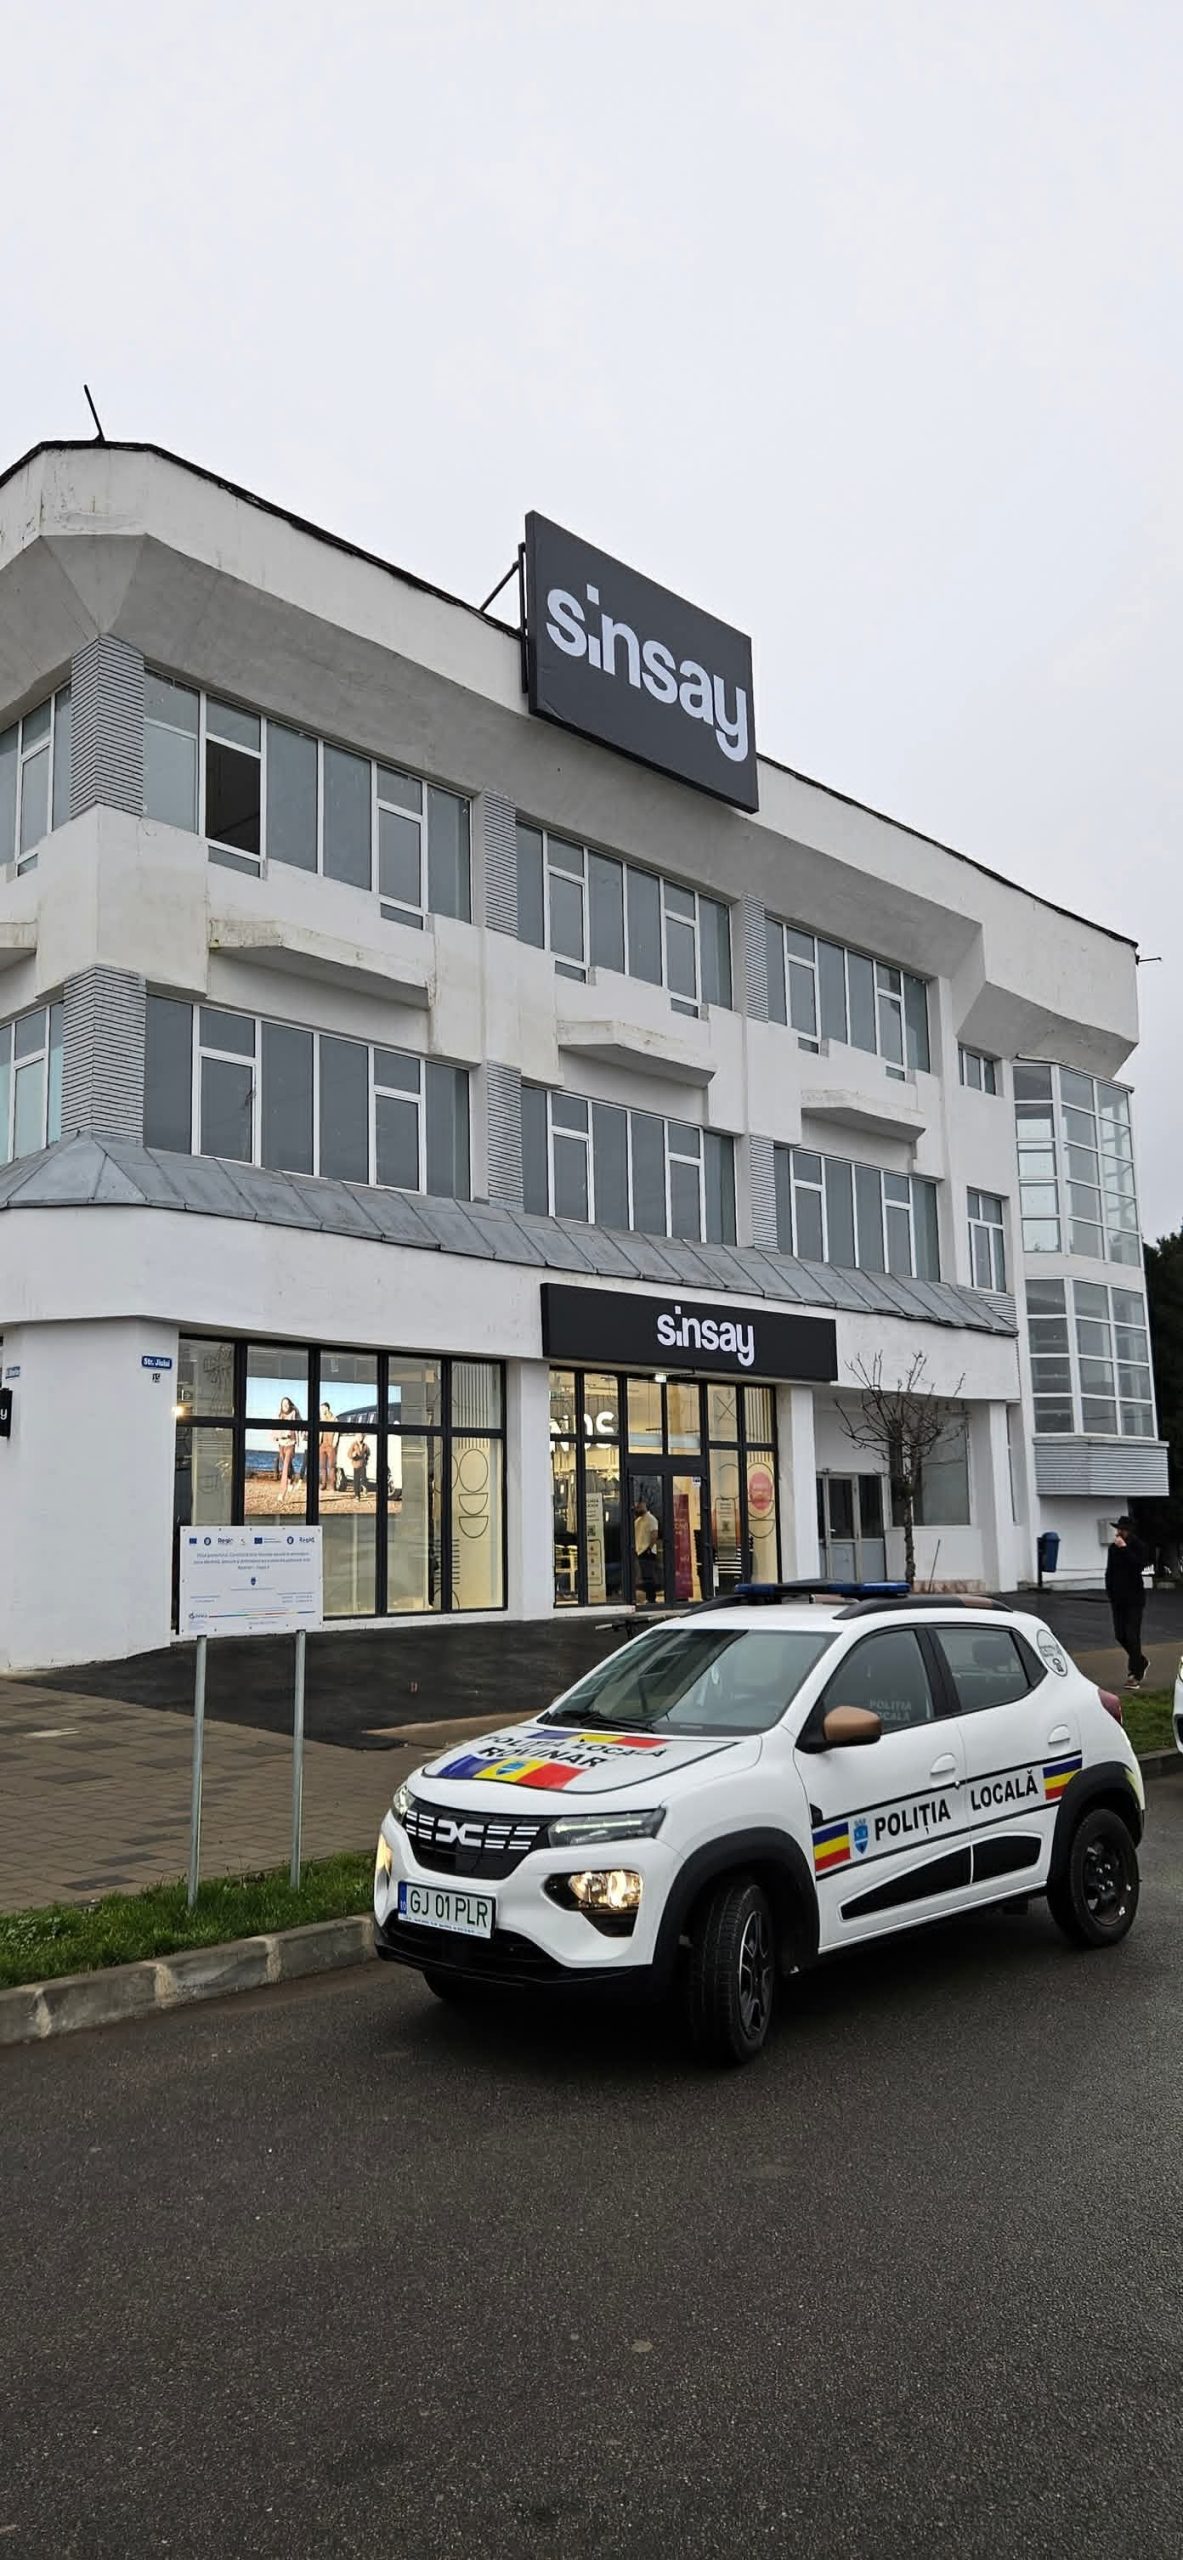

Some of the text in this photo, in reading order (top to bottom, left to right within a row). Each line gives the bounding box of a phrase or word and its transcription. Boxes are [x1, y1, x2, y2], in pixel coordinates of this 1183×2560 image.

[546, 583, 749, 762] sinsay
[657, 1305, 755, 1366] sinsay
[478, 1746, 608, 1767] ROVINAR
[874, 1769, 1039, 1841] POLIȚIA LOCALĂ
[410, 1889, 429, 1915] GJ
[435, 1894, 450, 1921] 01
[455, 1897, 488, 1928] PLR
